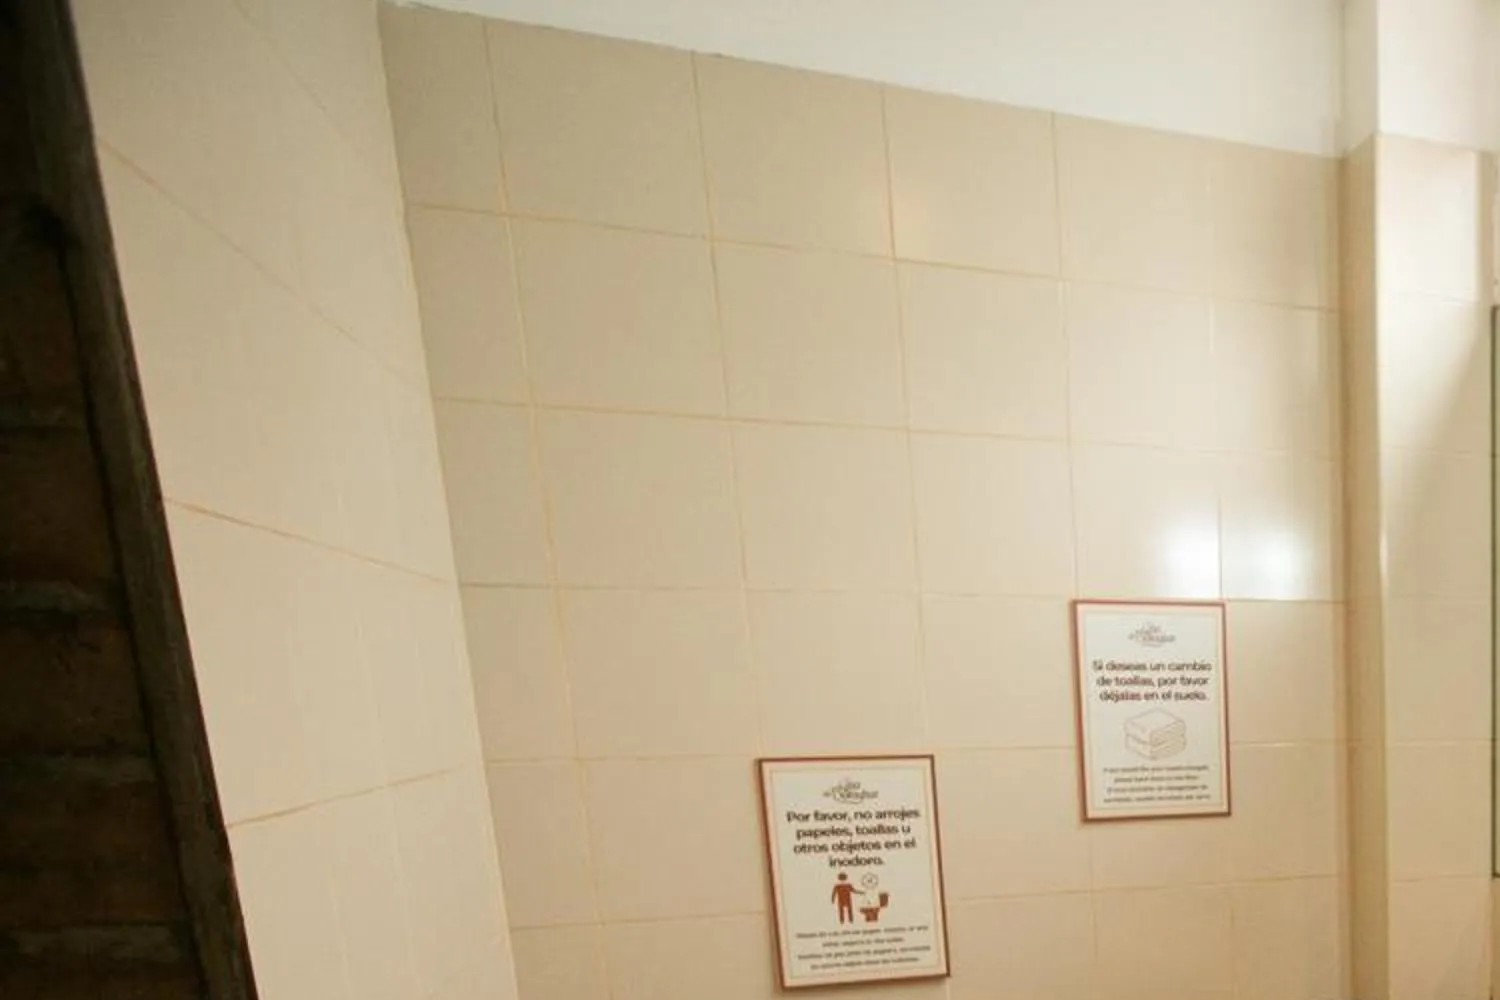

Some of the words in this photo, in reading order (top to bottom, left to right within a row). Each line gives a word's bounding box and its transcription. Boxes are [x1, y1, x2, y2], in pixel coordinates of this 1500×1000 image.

[1092, 659, 1103, 671] Si
[1105, 660, 1147, 671] deseas
[1149, 663, 1165, 671] un
[1167, 659, 1212, 671] cambio
[1096, 675, 1112, 686] de
[1157, 677, 1177, 688] por
[1179, 675, 1209, 686] favor
[1143, 691, 1159, 700] en
[1161, 689, 1172, 700] el
[786, 810, 810, 822] Por
[813, 809, 852, 822] favor,
[853, 810, 873, 821] no
[875, 806, 920, 822] arrojes
[796, 826, 853, 841] papeles,
[855, 824, 900, 836] toallas
[901, 825, 911, 835] u
[793, 843, 829, 855] otros
[831, 840, 881, 855] objetos
[883, 840, 902, 850] en
[903, 836, 917, 849] el
[828, 855, 886, 868] inodoro.
